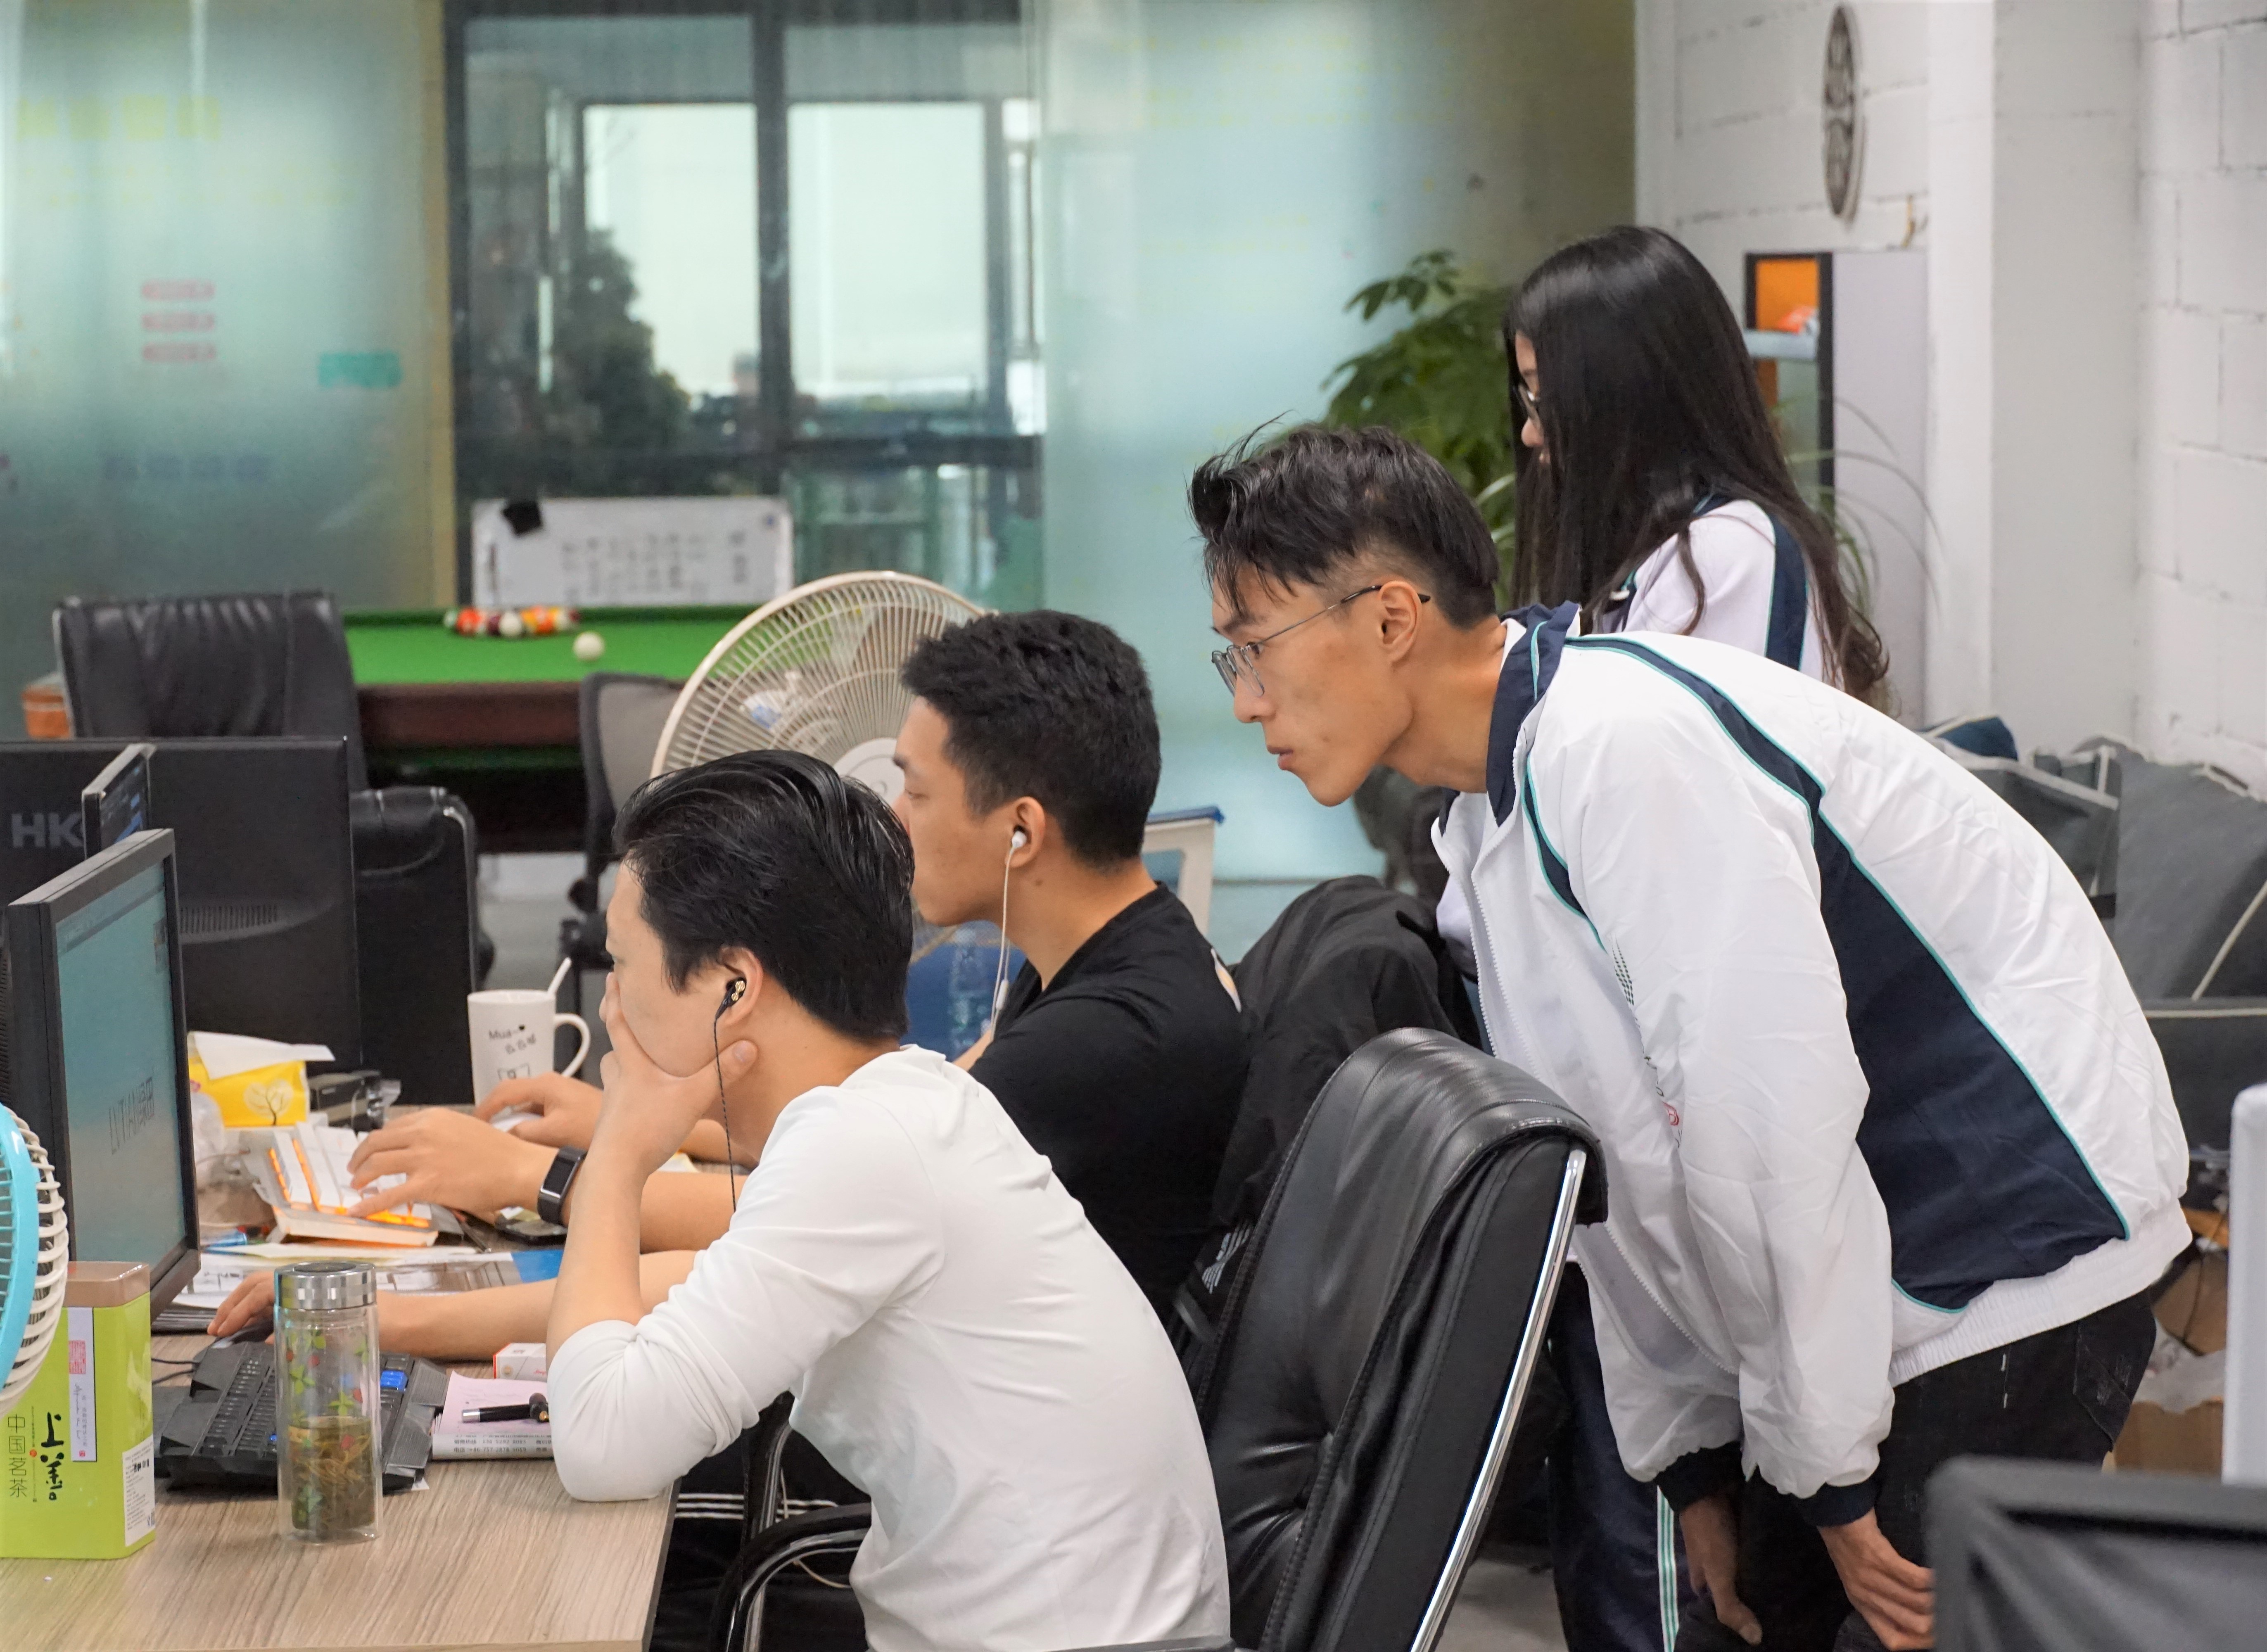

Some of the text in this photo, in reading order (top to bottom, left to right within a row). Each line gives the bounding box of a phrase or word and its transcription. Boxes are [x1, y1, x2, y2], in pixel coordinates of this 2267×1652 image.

[11, 813, 85, 848] HK
[7, 1413, 28, 1498] 中国茗茶
